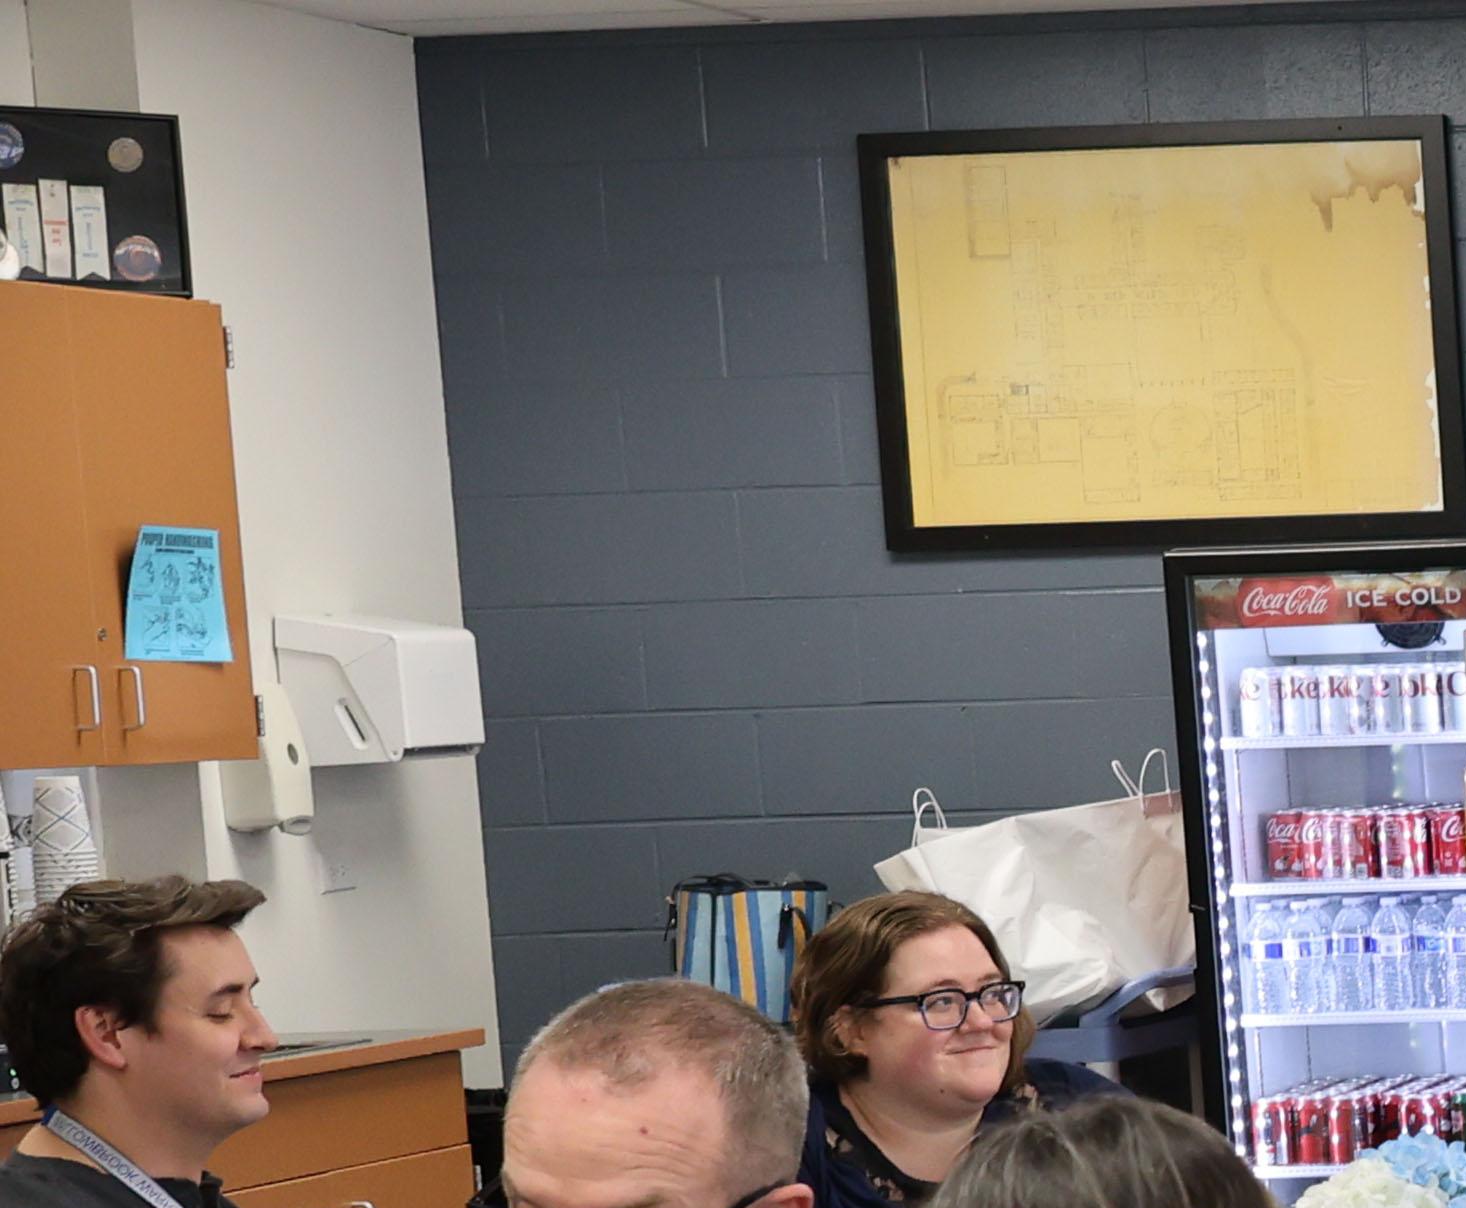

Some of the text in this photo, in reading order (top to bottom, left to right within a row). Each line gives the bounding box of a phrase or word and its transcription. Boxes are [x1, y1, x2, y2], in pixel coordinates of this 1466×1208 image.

[1242, 584, 1331, 617] Coca-Cola
[1346, 586, 1461, 609] ICE COLD
